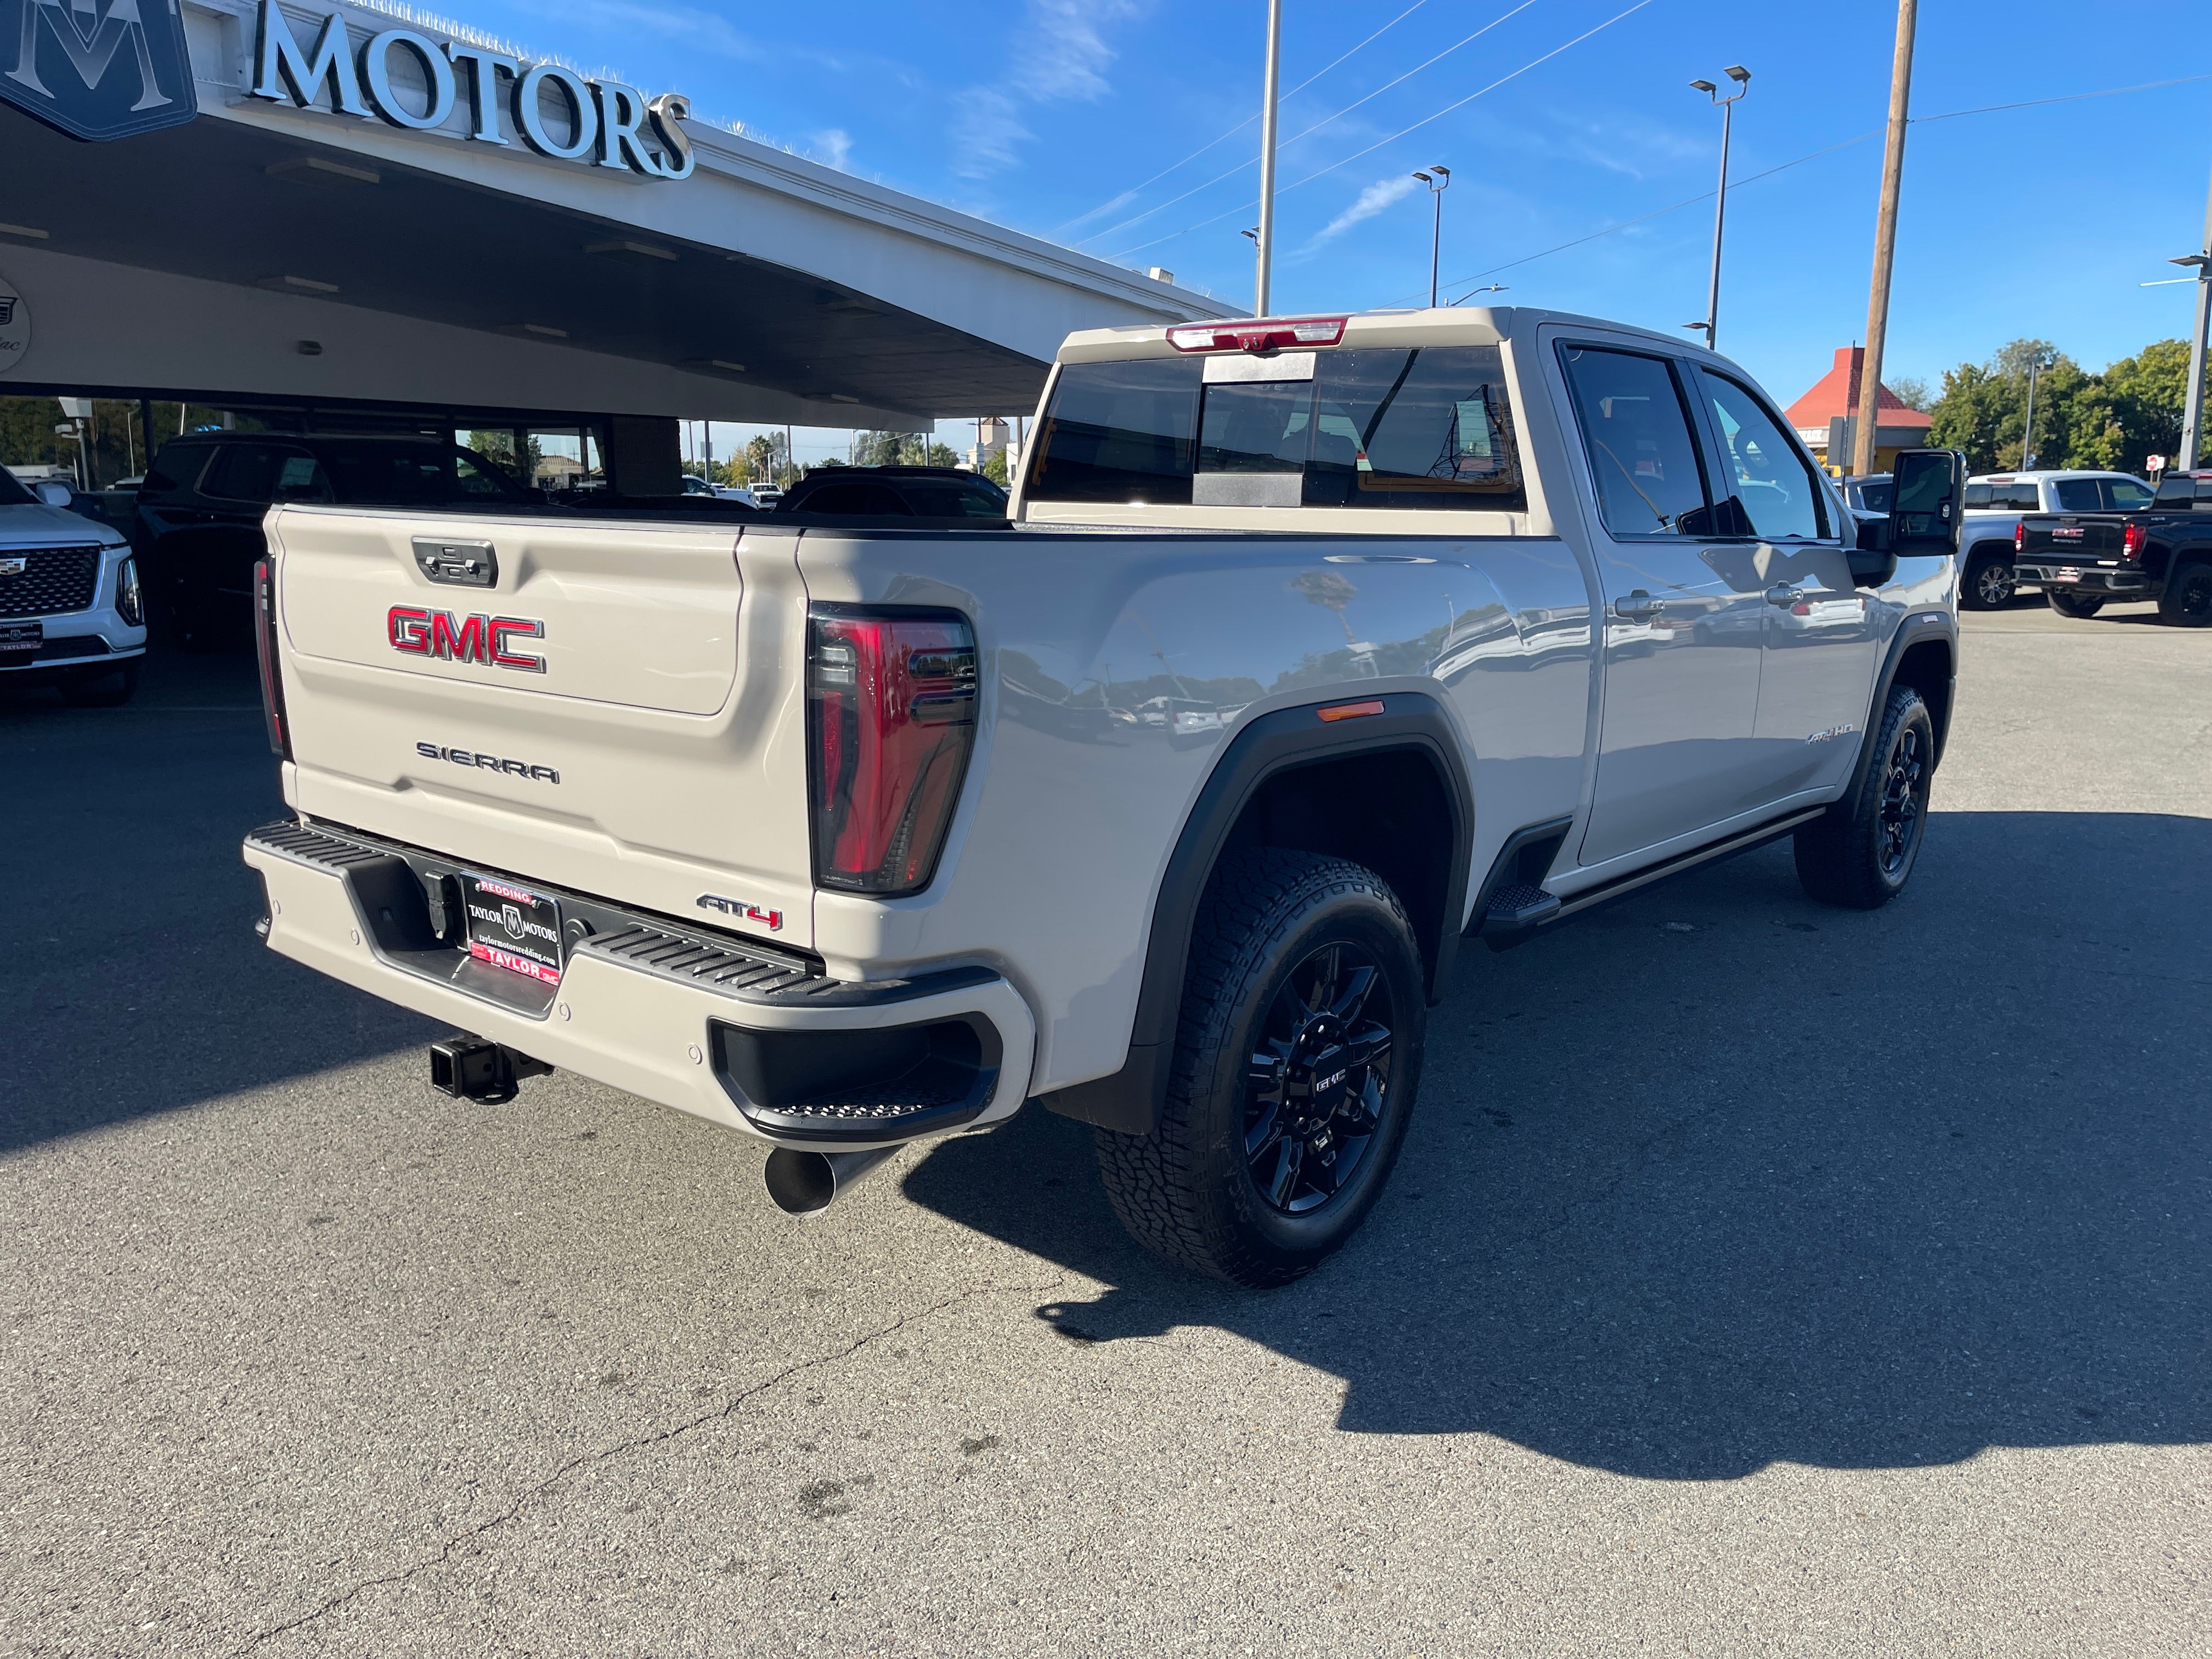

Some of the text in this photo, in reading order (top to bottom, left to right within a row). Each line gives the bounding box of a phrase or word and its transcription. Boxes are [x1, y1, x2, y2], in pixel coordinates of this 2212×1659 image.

[250, 0, 695, 180] MOTORS
[387, 604, 546, 674] GMC
[416, 740, 560, 785] SIERRA
[481, 881, 530, 902] REDDING
[469, 904, 504, 925] TAYLOR
[523, 921, 557, 943] MOTORS
[696, 892, 783, 932] AT4
[479, 934, 556, 966] taylormotorsredding.com
[487, 949, 540, 978] TAYLOR
[1317, 1069, 1346, 1092] GMC
